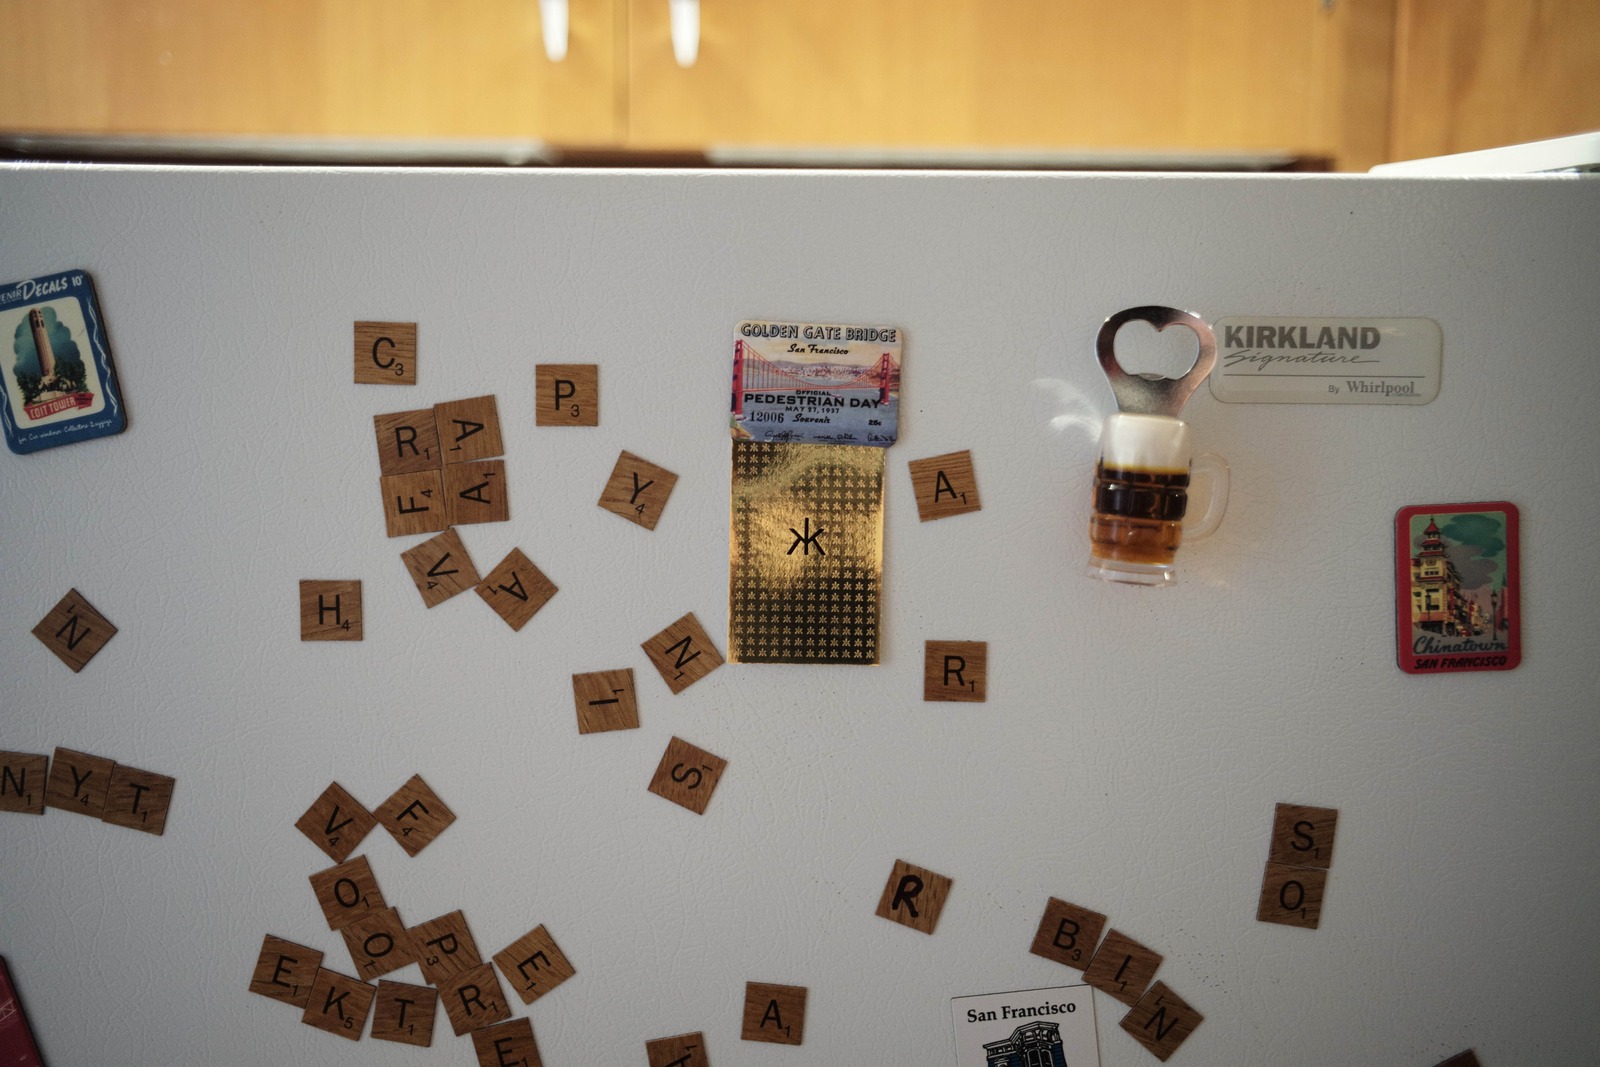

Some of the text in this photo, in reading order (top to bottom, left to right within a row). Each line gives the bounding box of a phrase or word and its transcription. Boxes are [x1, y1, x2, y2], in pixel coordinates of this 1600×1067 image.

[16, 277, 67, 300] DECALS
[741, 323, 897, 343] GOLDEN GATE BRIDGE
[1224, 325, 1381, 350] KIRKLAND
[371, 336, 396, 370] C
[787, 343, 849, 355] San Francisco
[1223, 349, 1380, 371] Signature
[554, 379, 576, 411] P
[744, 393, 880, 409] PEDESTRIAN DAY
[796, 389, 831, 397] OFFICIAL
[1328, 384, 1340, 395] By
[1346, 380, 1415, 396] Whirlpool
[30, 406, 48, 419] COIT
[50, 397, 76, 413] TOWER
[750, 411, 785, 424] 12006
[785, 405, 805, 413] MAY
[792, 413, 831, 424] Souvenir
[394, 425, 420, 458] R
[452, 419, 485, 443] A
[459, 481, 491, 505] A
[629, 472, 654, 505] Y
[934, 470, 958, 503] A
[397, 495, 430, 515] F
[426, 552, 459, 578] V
[498, 571, 529, 602] A
[318, 594, 341, 625] H
[55, 614, 91, 651] N
[1414, 636, 1507, 655] Chinatown
[664, 635, 701, 670] N
[1414, 656, 1507, 669] SAN FRANCISCO
[943, 655, 966, 687] R
[588, 698, 619, 706] I
[0, 765, 26, 798] N
[70, 765, 93, 798] Y
[129, 782, 151, 815] T
[670, 762, 703, 790] S
[324, 804, 354, 836] V
[395, 799, 430, 822] F
[1290, 820, 1315, 852] S
[334, 877, 360, 909] O
[891, 874, 924, 919] R
[1279, 880, 1305, 911] O
[363, 932, 394, 958] O
[425, 932, 459, 955] P
[1052, 917, 1081, 951] B
[271, 954, 298, 989] E
[516, 950, 552, 982] E
[1114, 954, 1133, 983] I
[322, 986, 350, 1021] K
[394, 997, 415, 1029] T
[457, 984, 488, 1017] R
[760, 999, 783, 1030] A
[967, 1001, 1076, 1023] San Francisco
[1143, 1006, 1179, 1042] N
[493, 1036, 520, 1067] E
